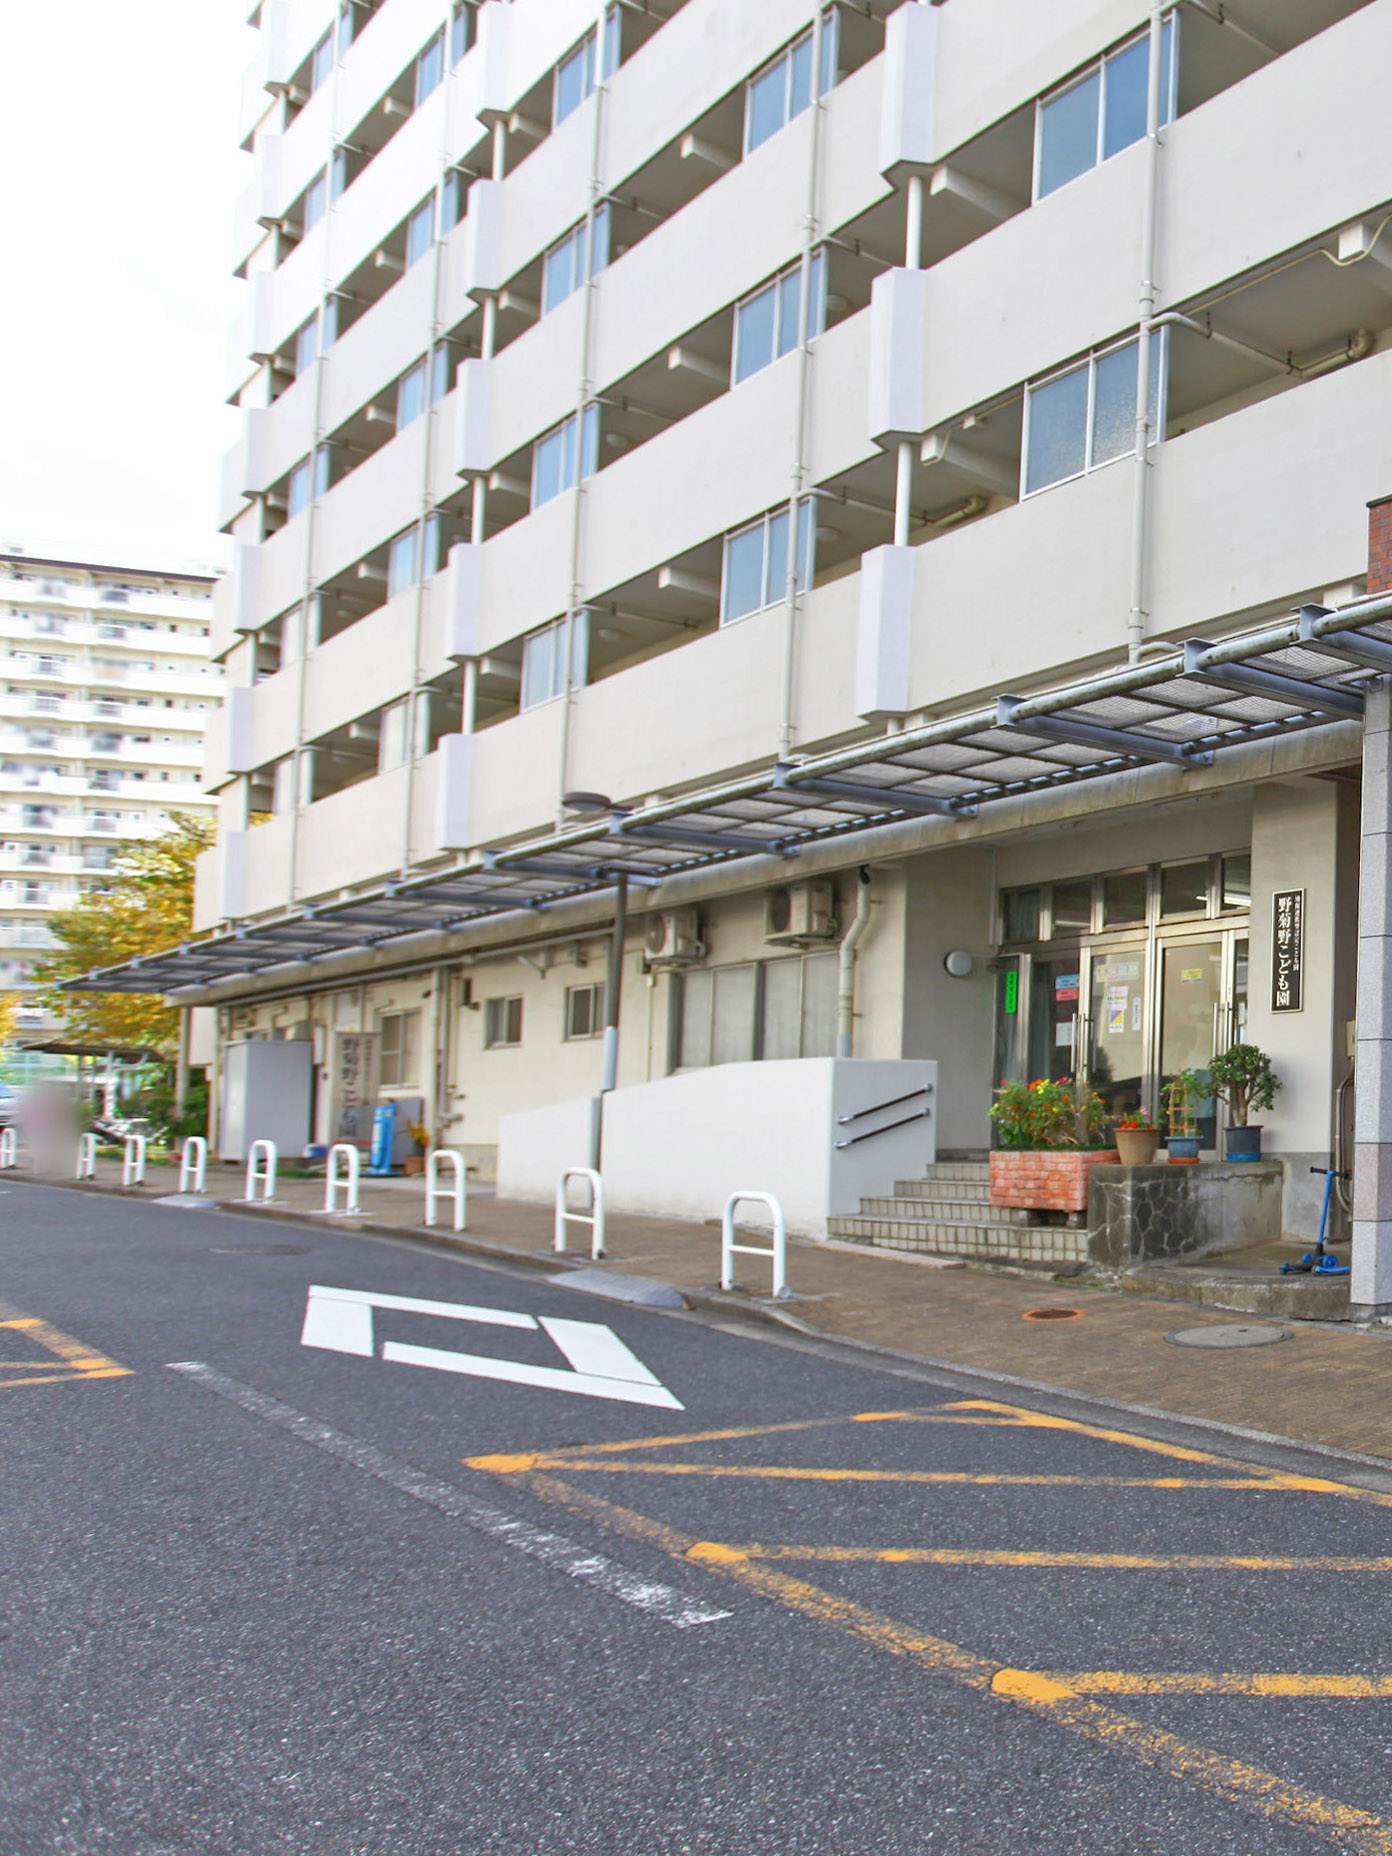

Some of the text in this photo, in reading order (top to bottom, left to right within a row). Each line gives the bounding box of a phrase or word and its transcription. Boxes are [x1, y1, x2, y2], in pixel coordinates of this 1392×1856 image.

[1276, 896, 1292, 1007] 野菊野こども園
